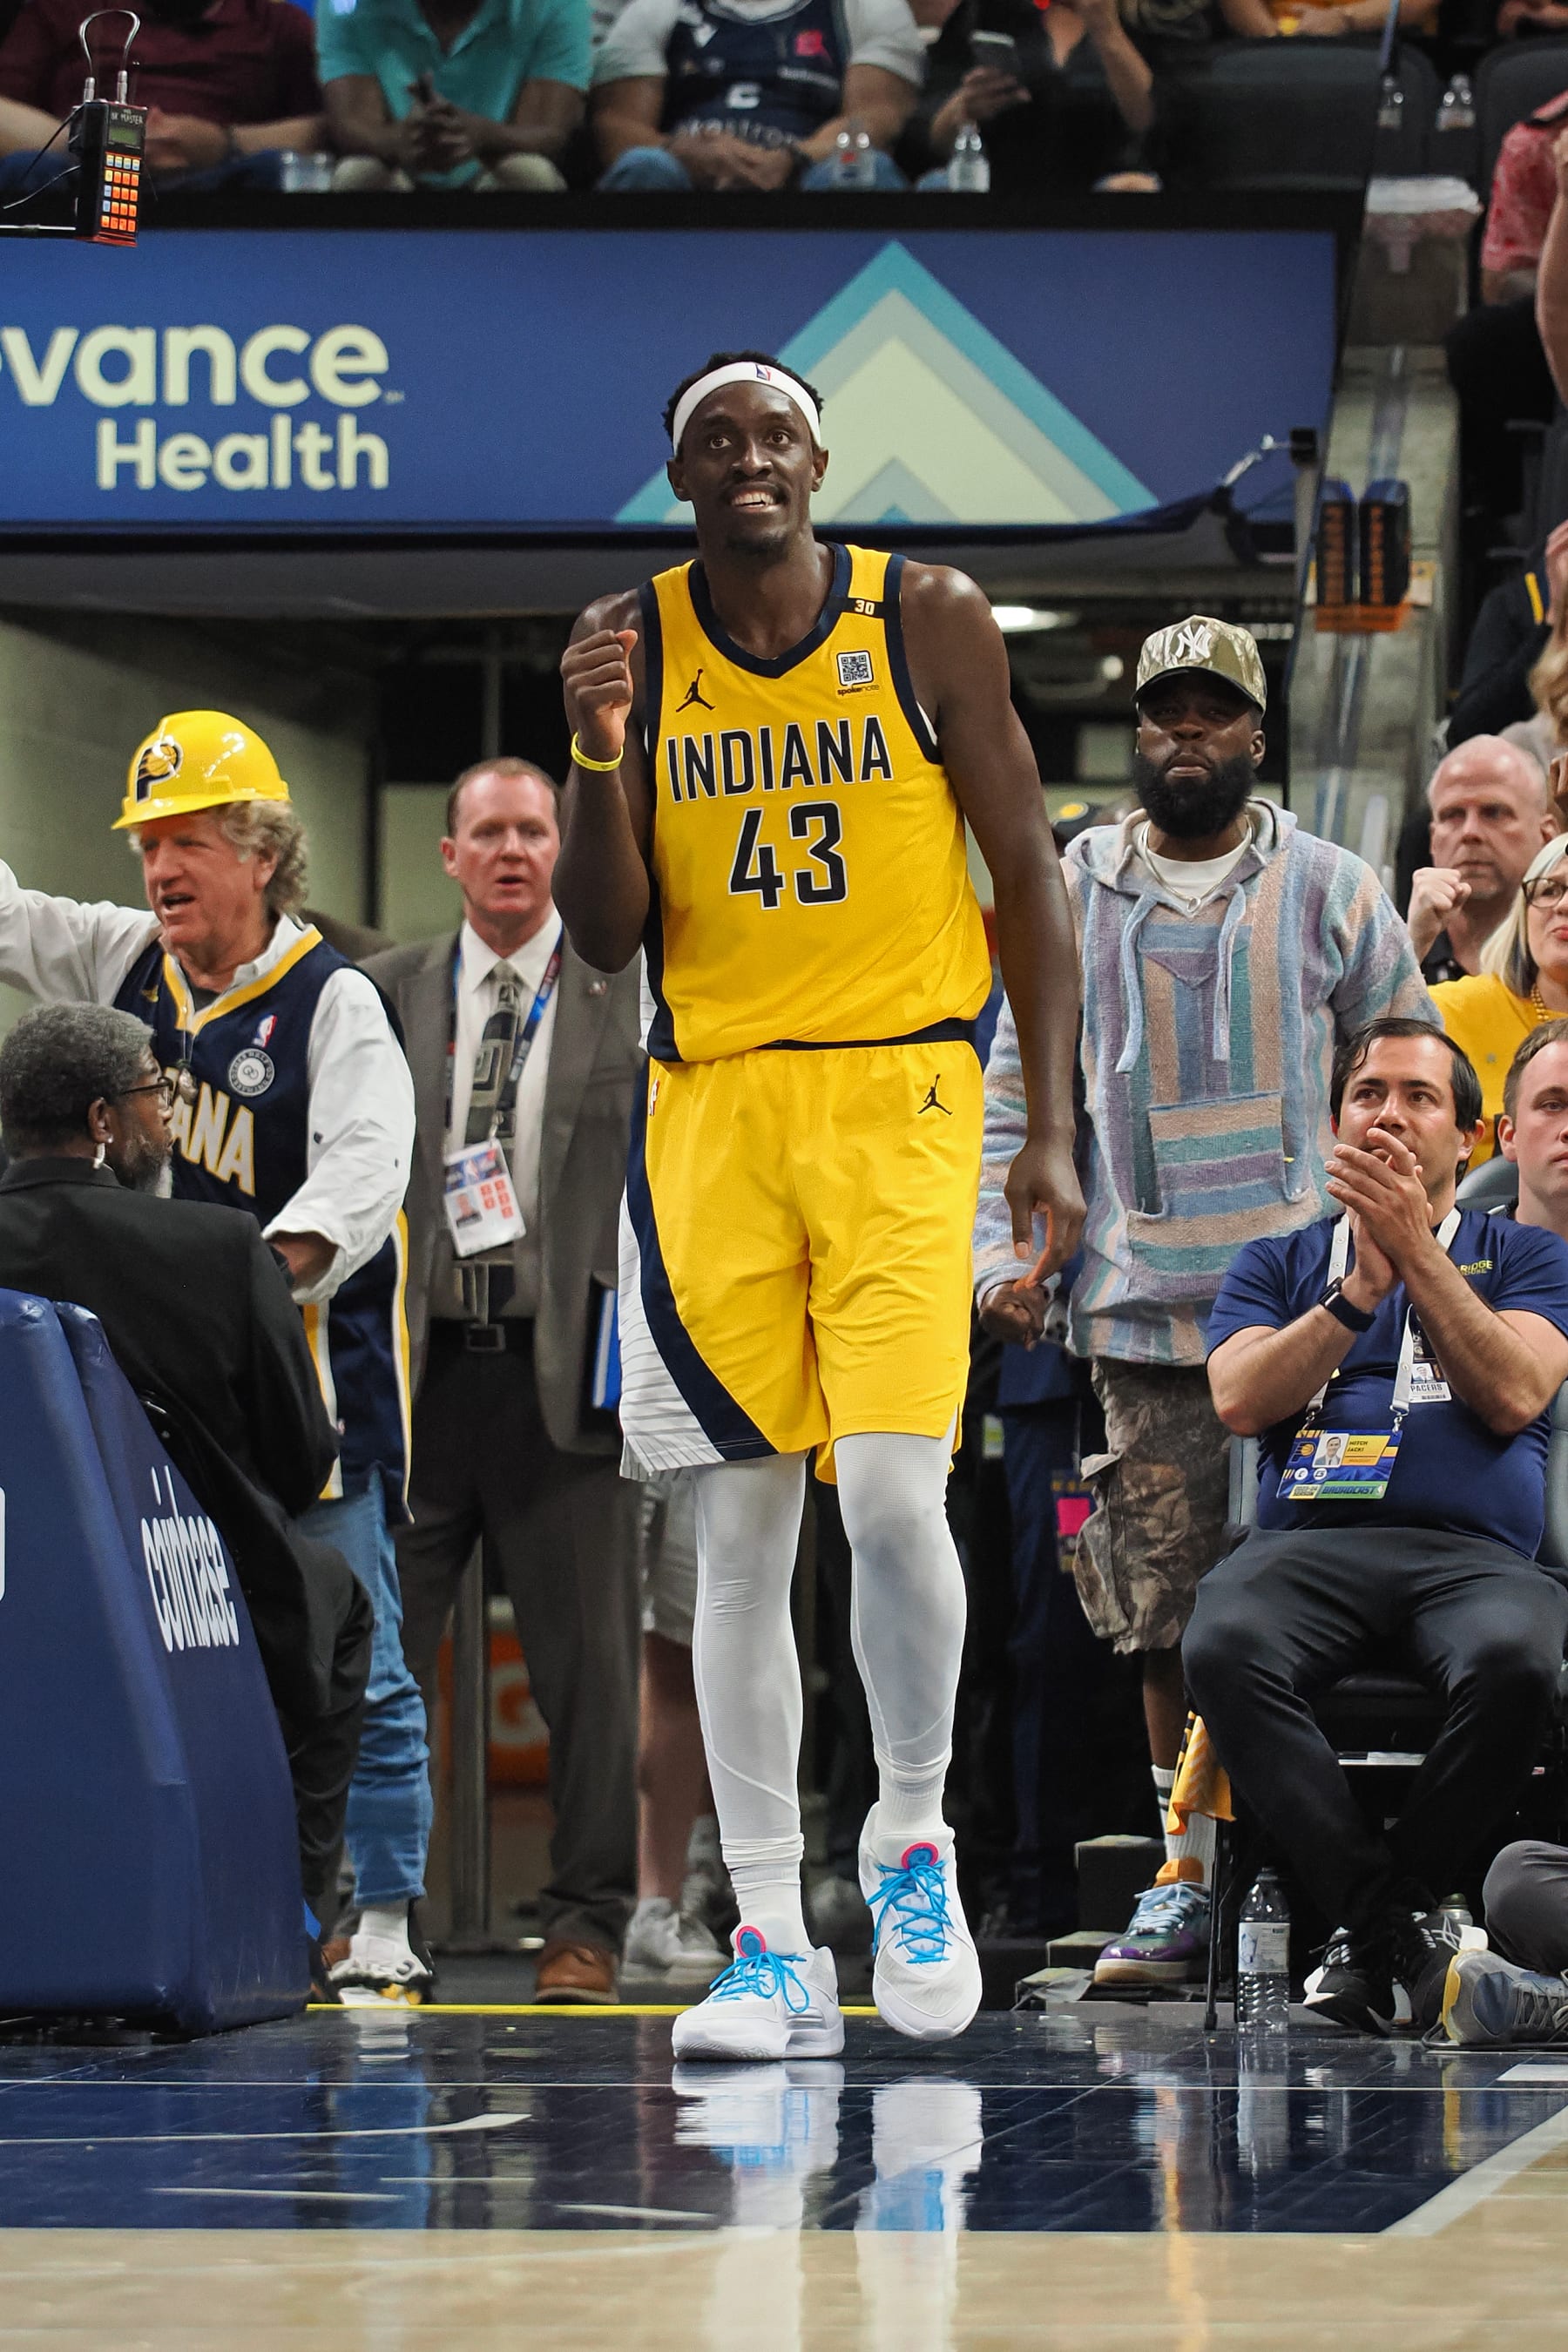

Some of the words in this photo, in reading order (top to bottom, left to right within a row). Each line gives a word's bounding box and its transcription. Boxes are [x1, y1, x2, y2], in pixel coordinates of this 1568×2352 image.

[0, 324, 389, 407] vance
[97, 413, 389, 490] Health
[855, 599, 875, 615] 30
[1176, 624, 1212, 659] NY
[837, 685, 880, 696] spokenote
[666, 714, 894, 803] INDIANA
[728, 801, 849, 910] 43
[165, 1067, 256, 1197] ANA
[1460, 1260, 1493, 1272] RIDGE
[1410, 1383, 1443, 1392] PACERS
[1322, 1485, 1377, 1495] BROADCAST
[141, 1465, 240, 1652] coinbase
